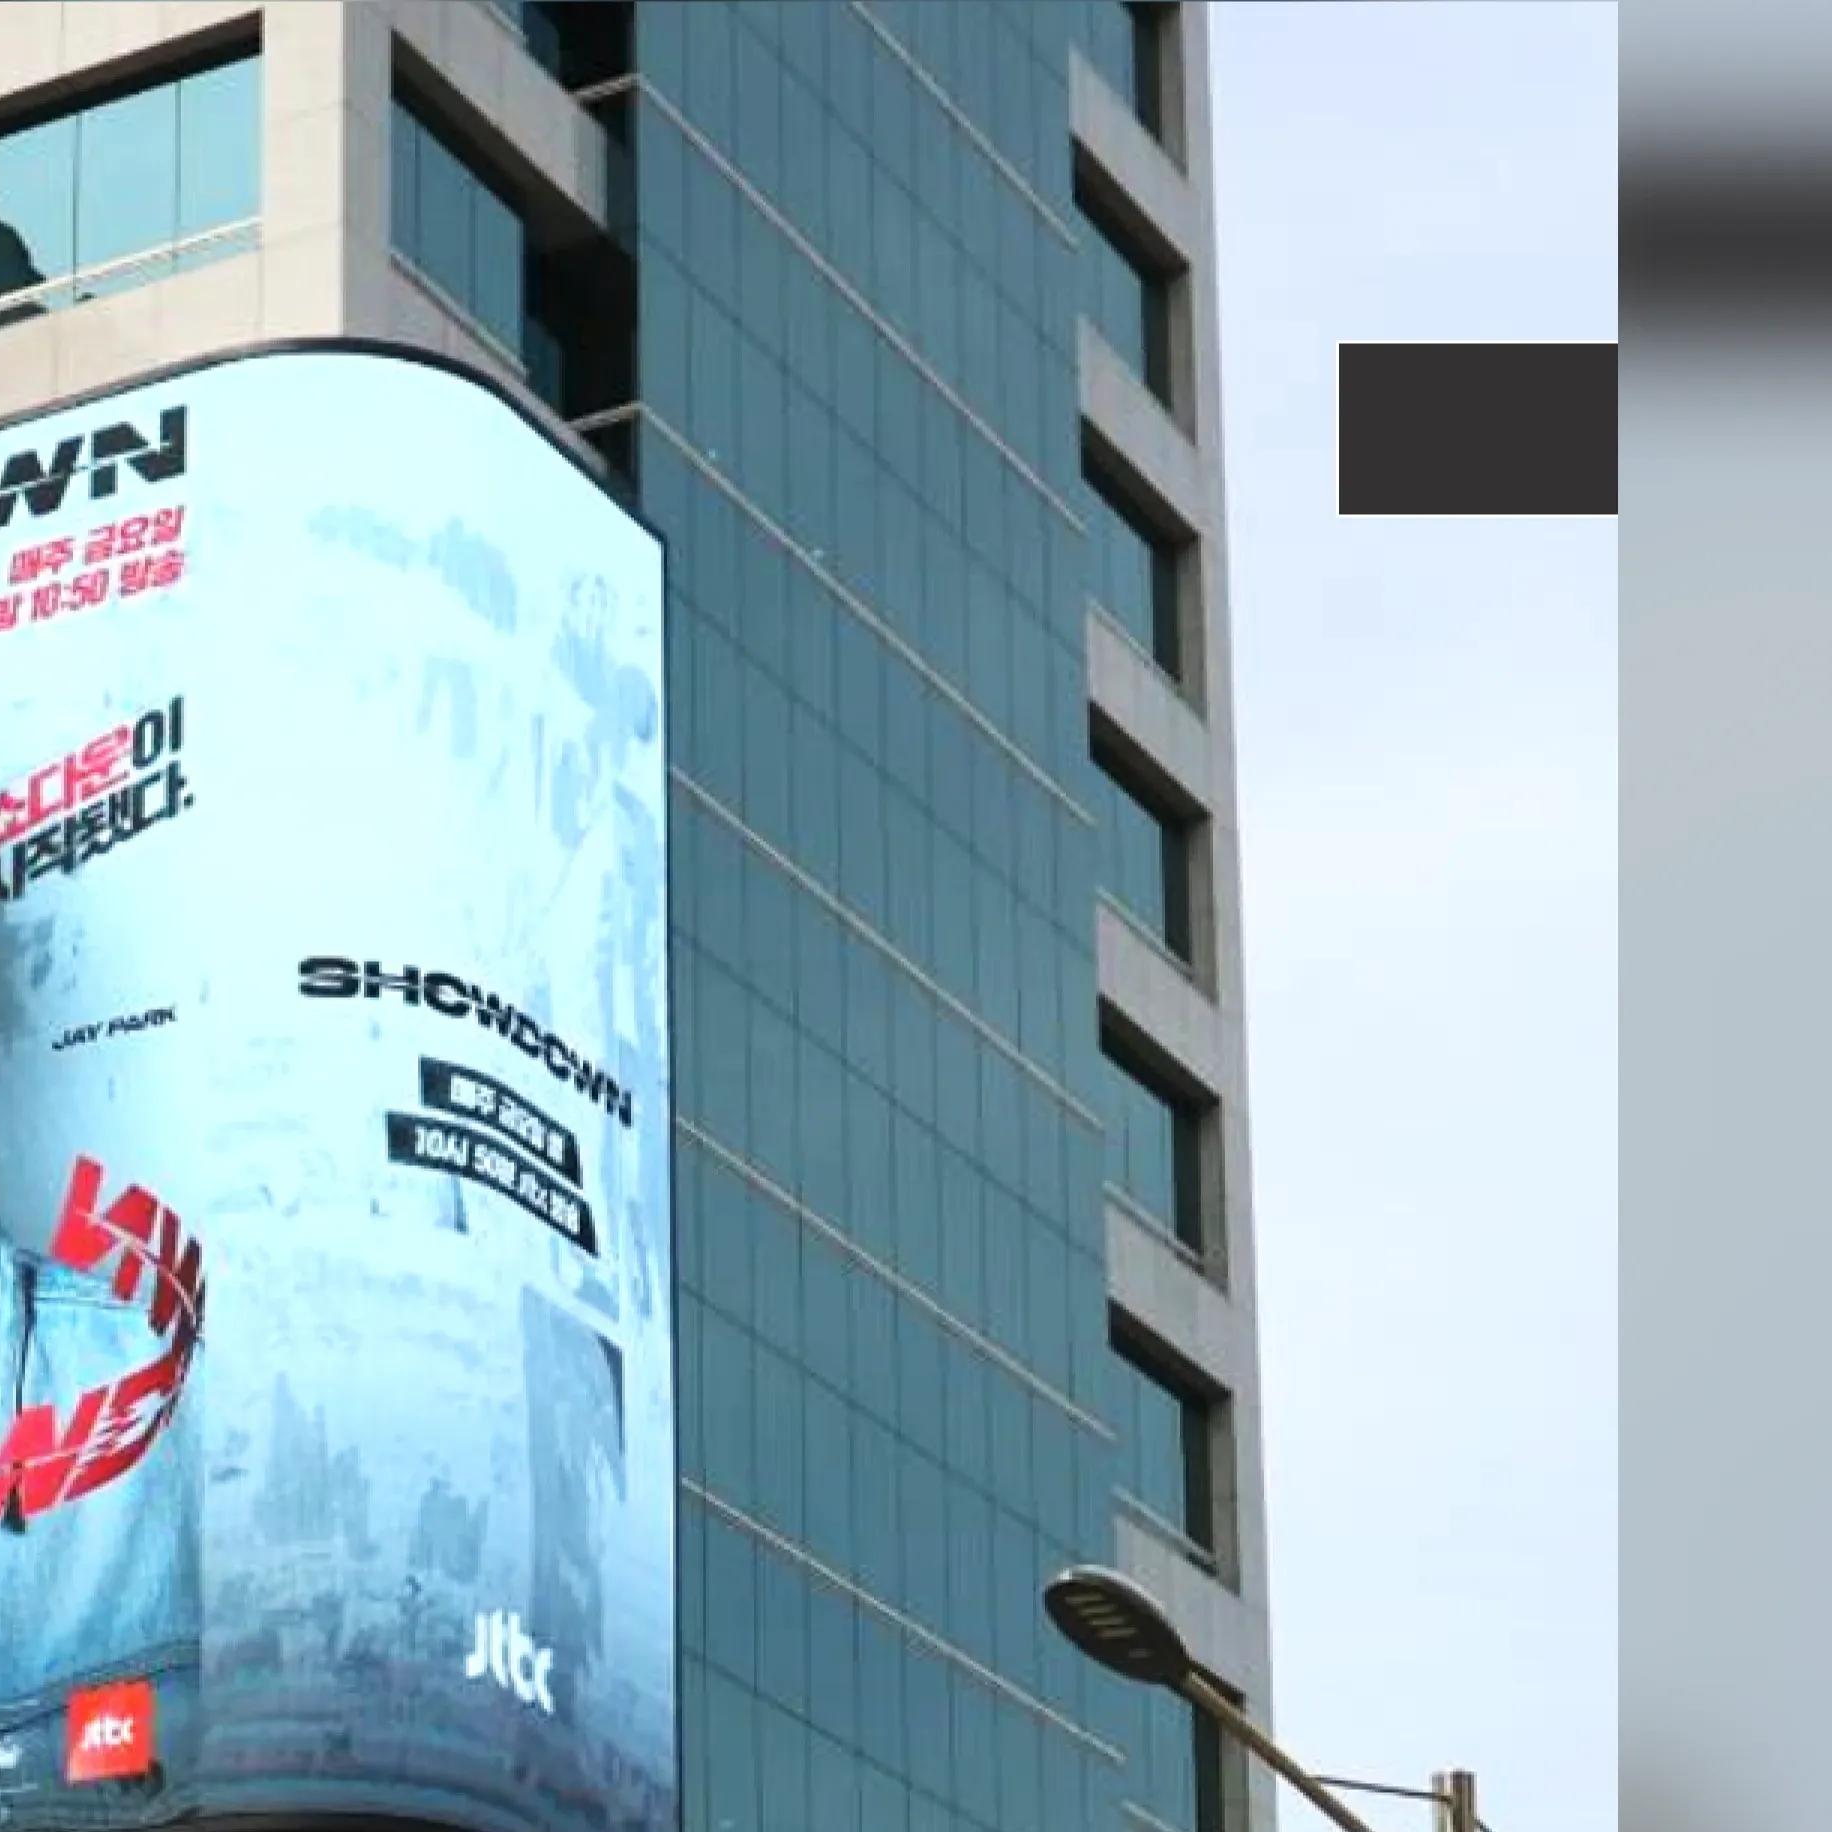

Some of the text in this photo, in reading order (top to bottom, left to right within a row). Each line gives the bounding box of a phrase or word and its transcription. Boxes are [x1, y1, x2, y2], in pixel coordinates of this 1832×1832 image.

[9, 505, 185, 585] 매주 금요일
[31, 568, 110, 621] 10:50
[51, 1004, 176, 1052] JAY PARK
[297, 956, 633, 1128] SHOWDOWN
